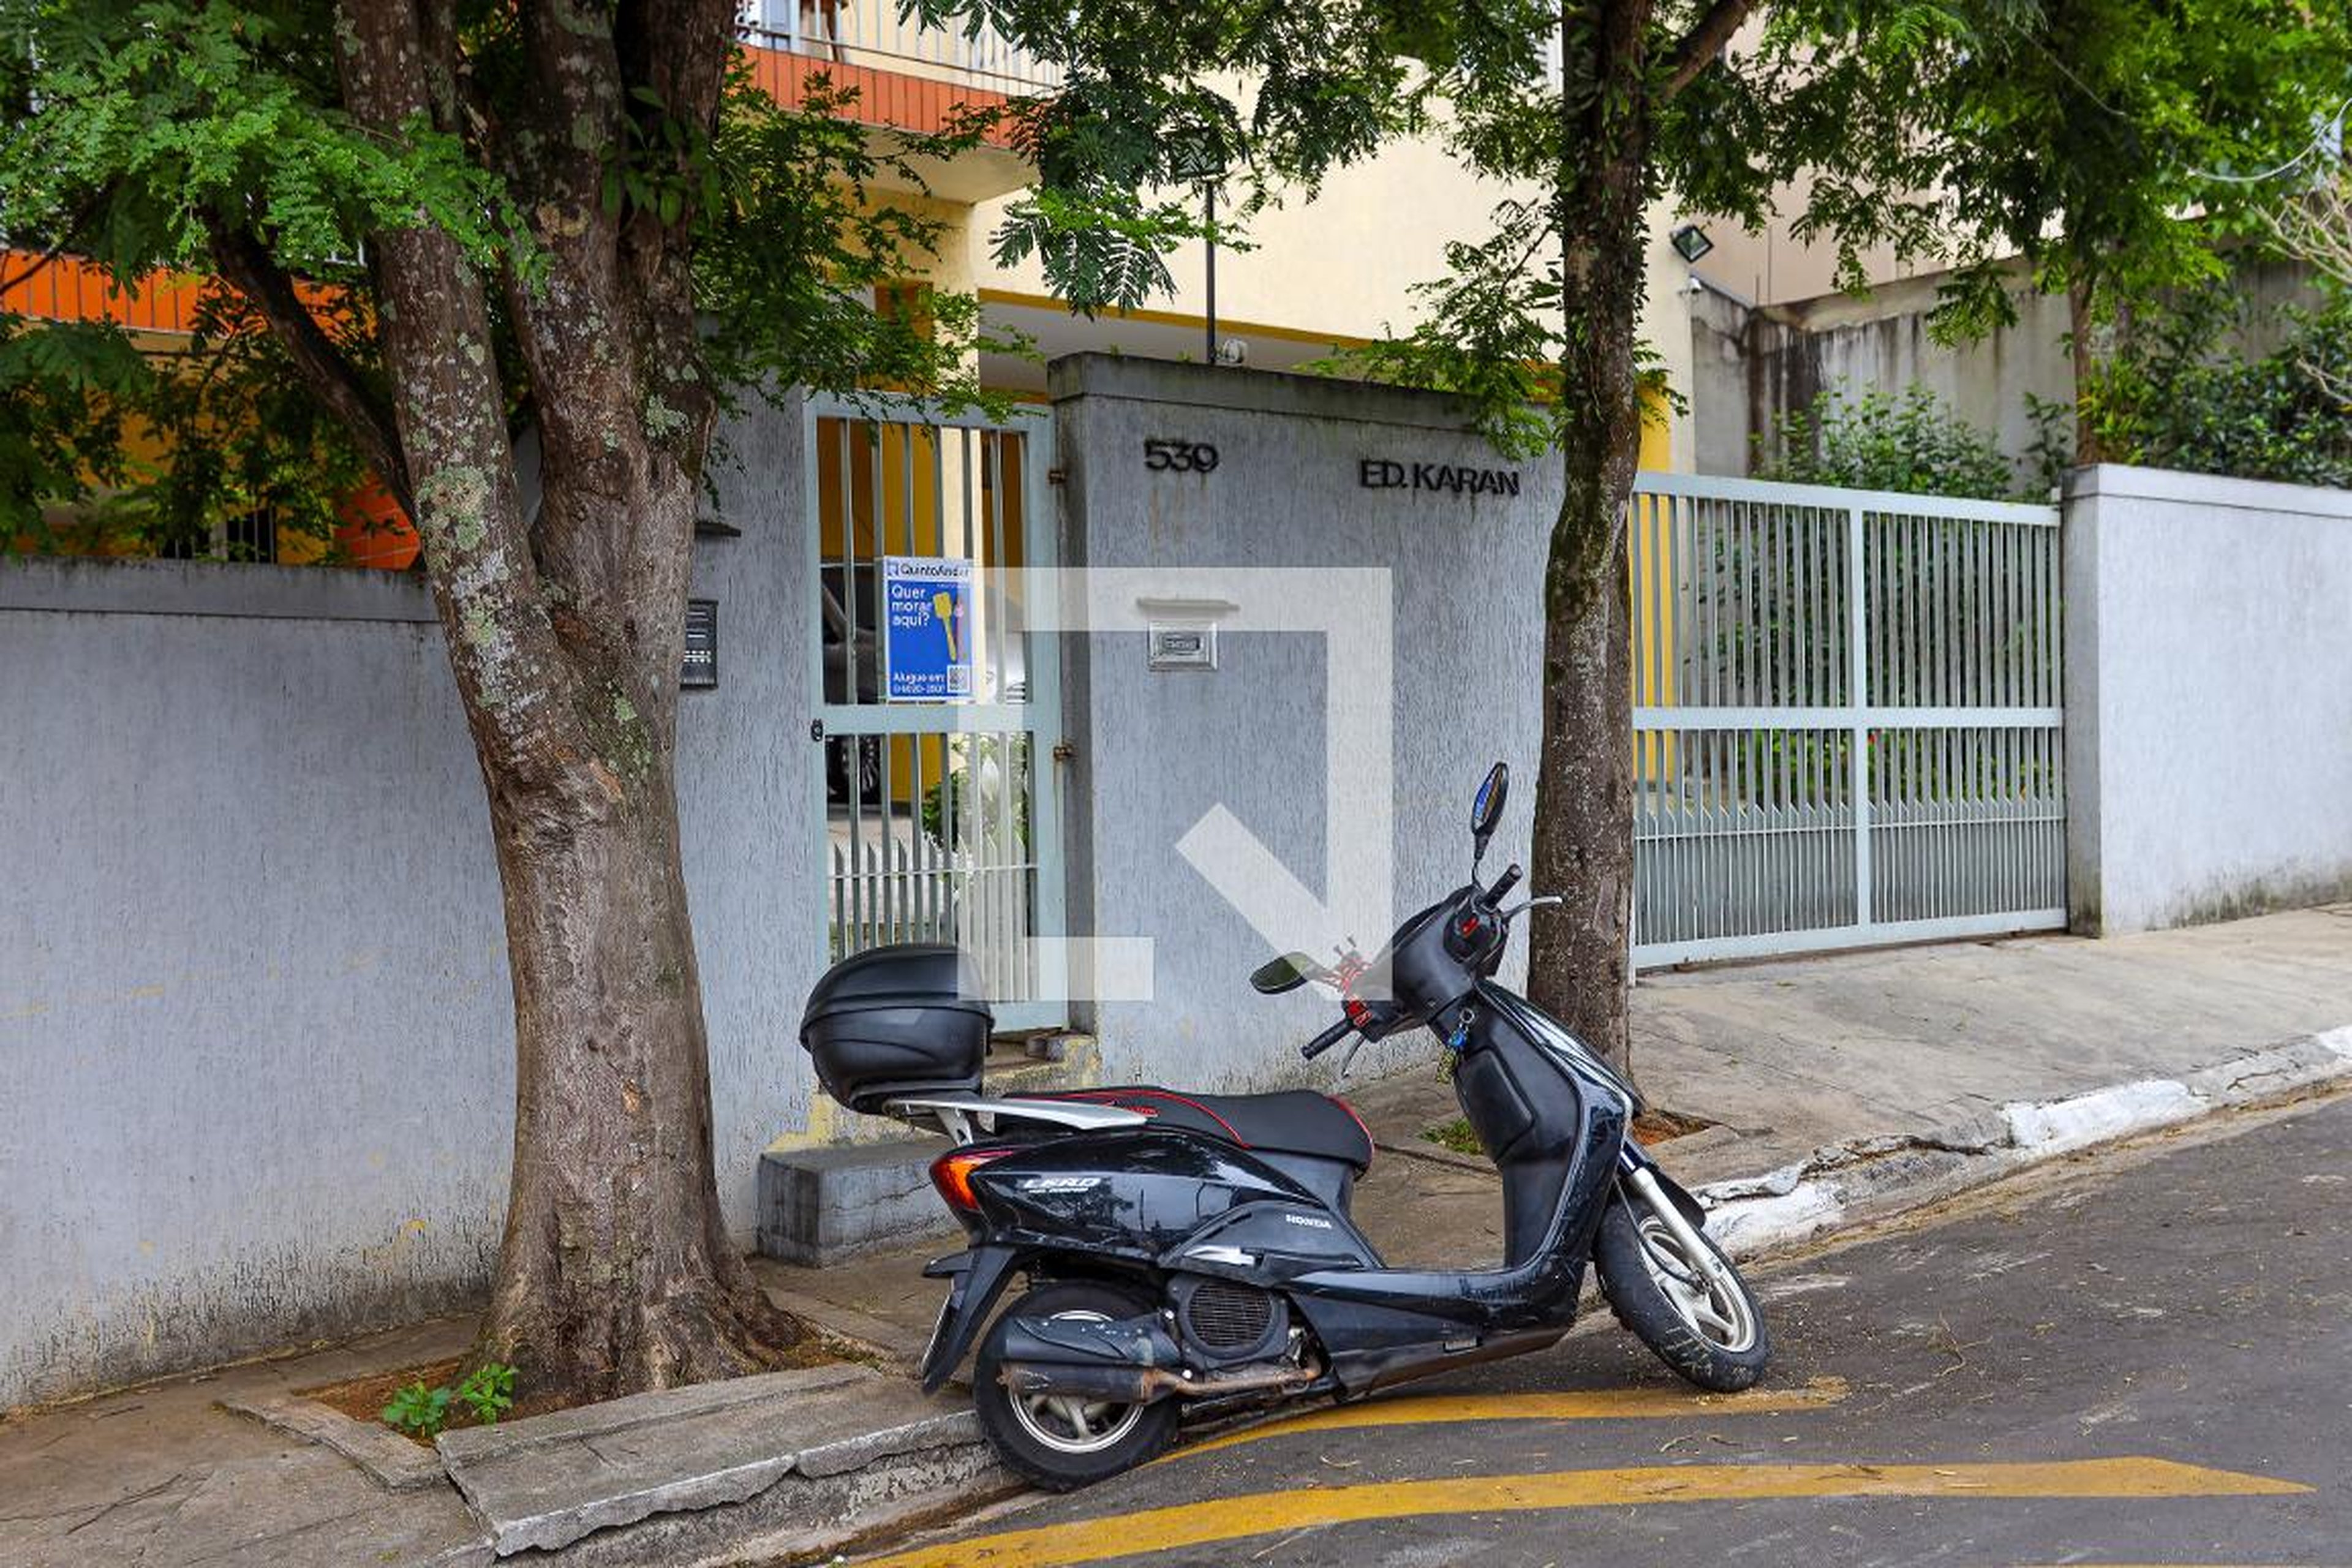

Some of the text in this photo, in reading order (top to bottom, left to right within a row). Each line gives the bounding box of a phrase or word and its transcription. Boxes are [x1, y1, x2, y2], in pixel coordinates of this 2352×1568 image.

[1144, 438, 1219, 473] 539
[1360, 459, 1520, 497] ED. KARAN
[891, 584, 925, 599] Quer
[892, 601, 933, 612] morar
[892, 613, 930, 628] aqui?
[1286, 1214, 1332, 1229] HONDA
